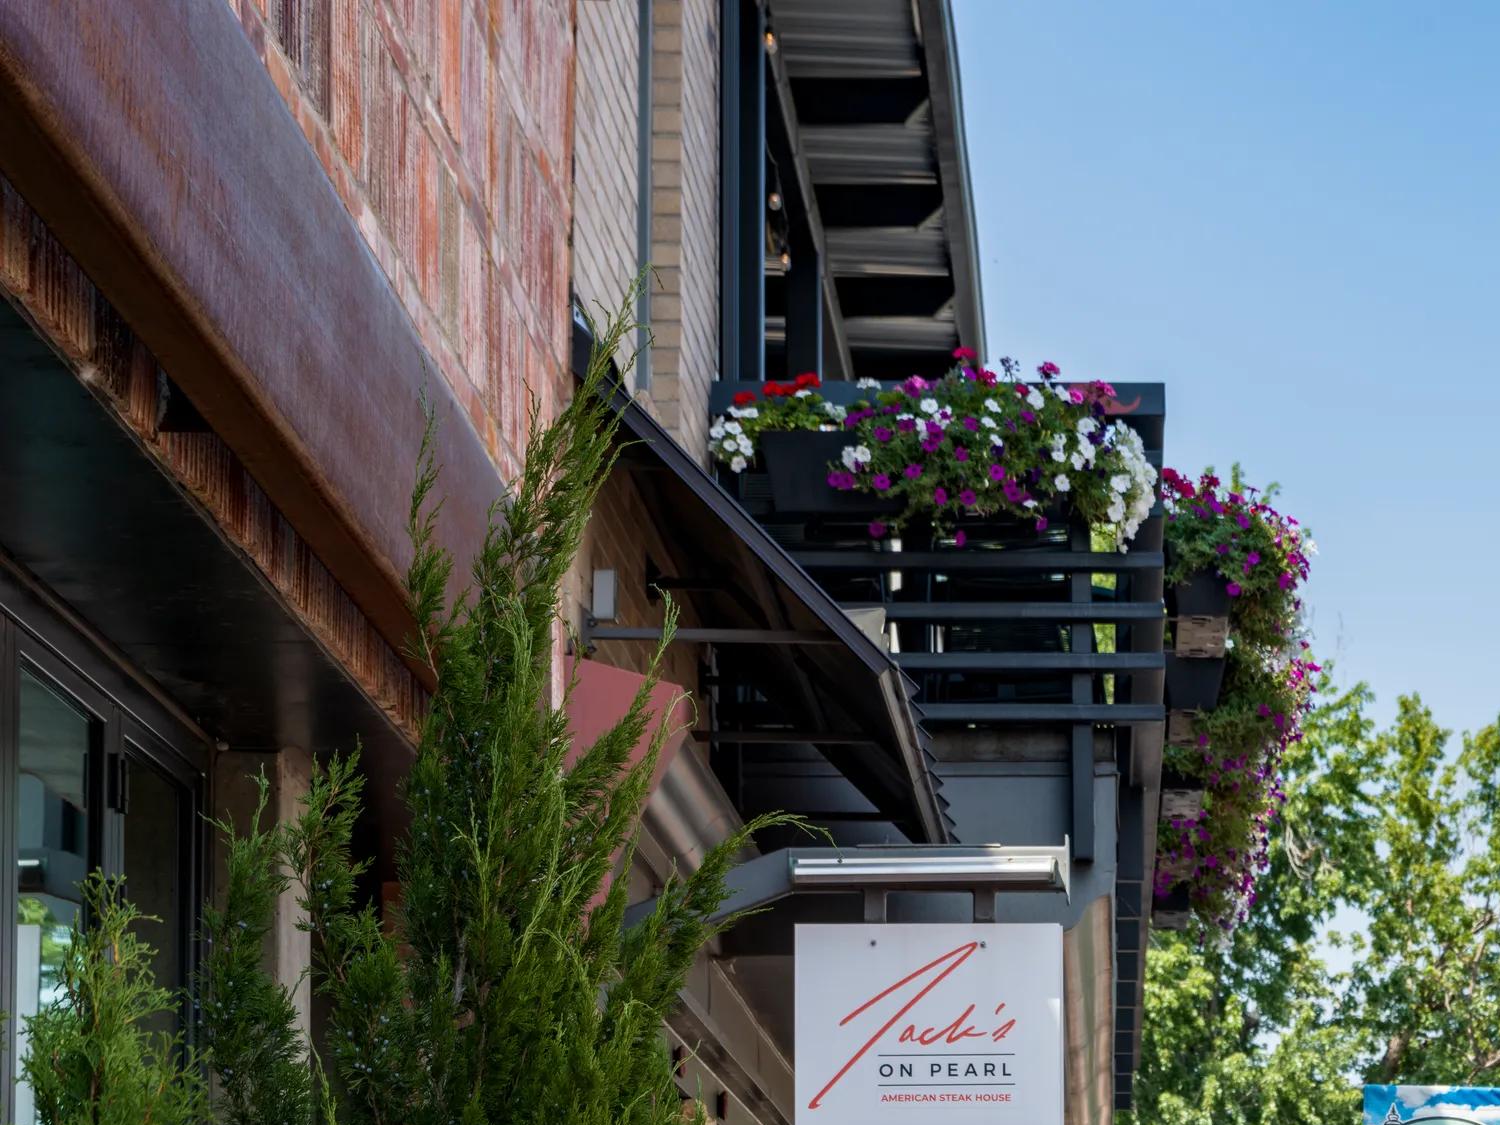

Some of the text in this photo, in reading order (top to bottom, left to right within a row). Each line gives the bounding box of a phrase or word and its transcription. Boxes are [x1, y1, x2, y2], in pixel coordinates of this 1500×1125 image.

[879, 1062, 1012, 1077] ON PEARL
[881, 1093, 1012, 1102] AMERICAN STEAK HOUSE
